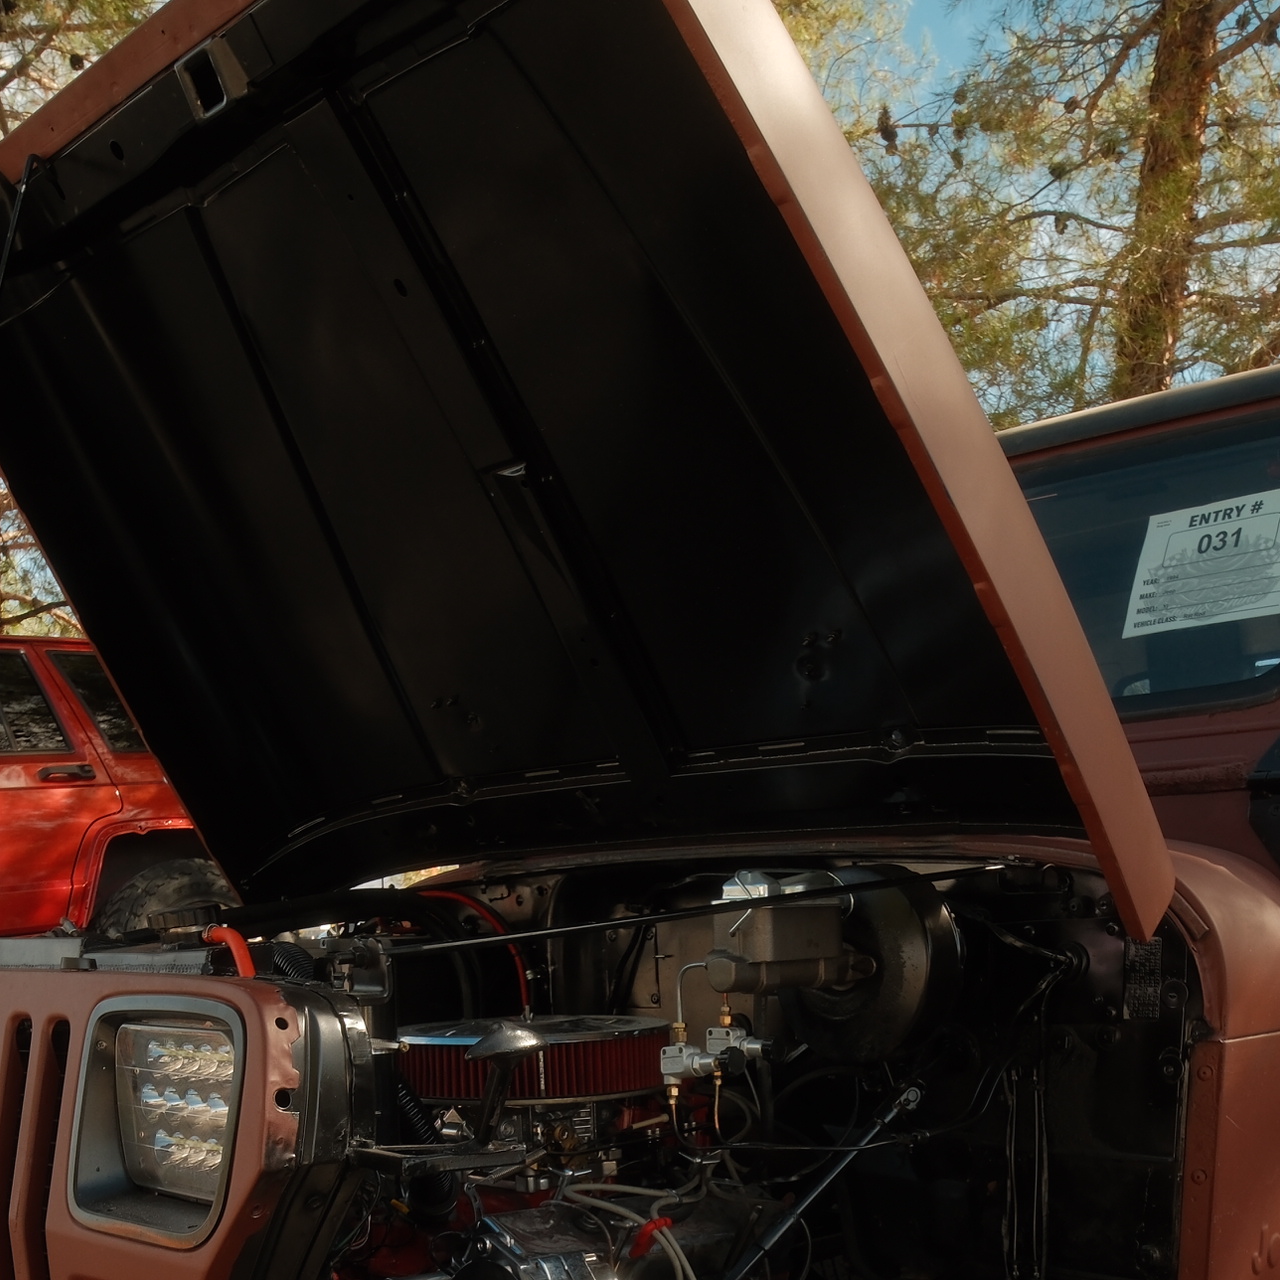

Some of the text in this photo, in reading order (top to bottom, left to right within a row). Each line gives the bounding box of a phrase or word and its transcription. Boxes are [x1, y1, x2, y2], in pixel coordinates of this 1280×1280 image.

[1188, 504, 1246, 528] ENTRY
[1250, 500, 1264, 514] #
[1197, 527, 1244, 555] 031
[1143, 577, 1160, 586] YEAR:
[1139, 591, 1158, 600] MAKE:
[1136, 605, 1158, 615] MODEL:
[1133, 618, 1157, 629] VEHICLE
[1157, 615, 1178, 625] CLASS:
